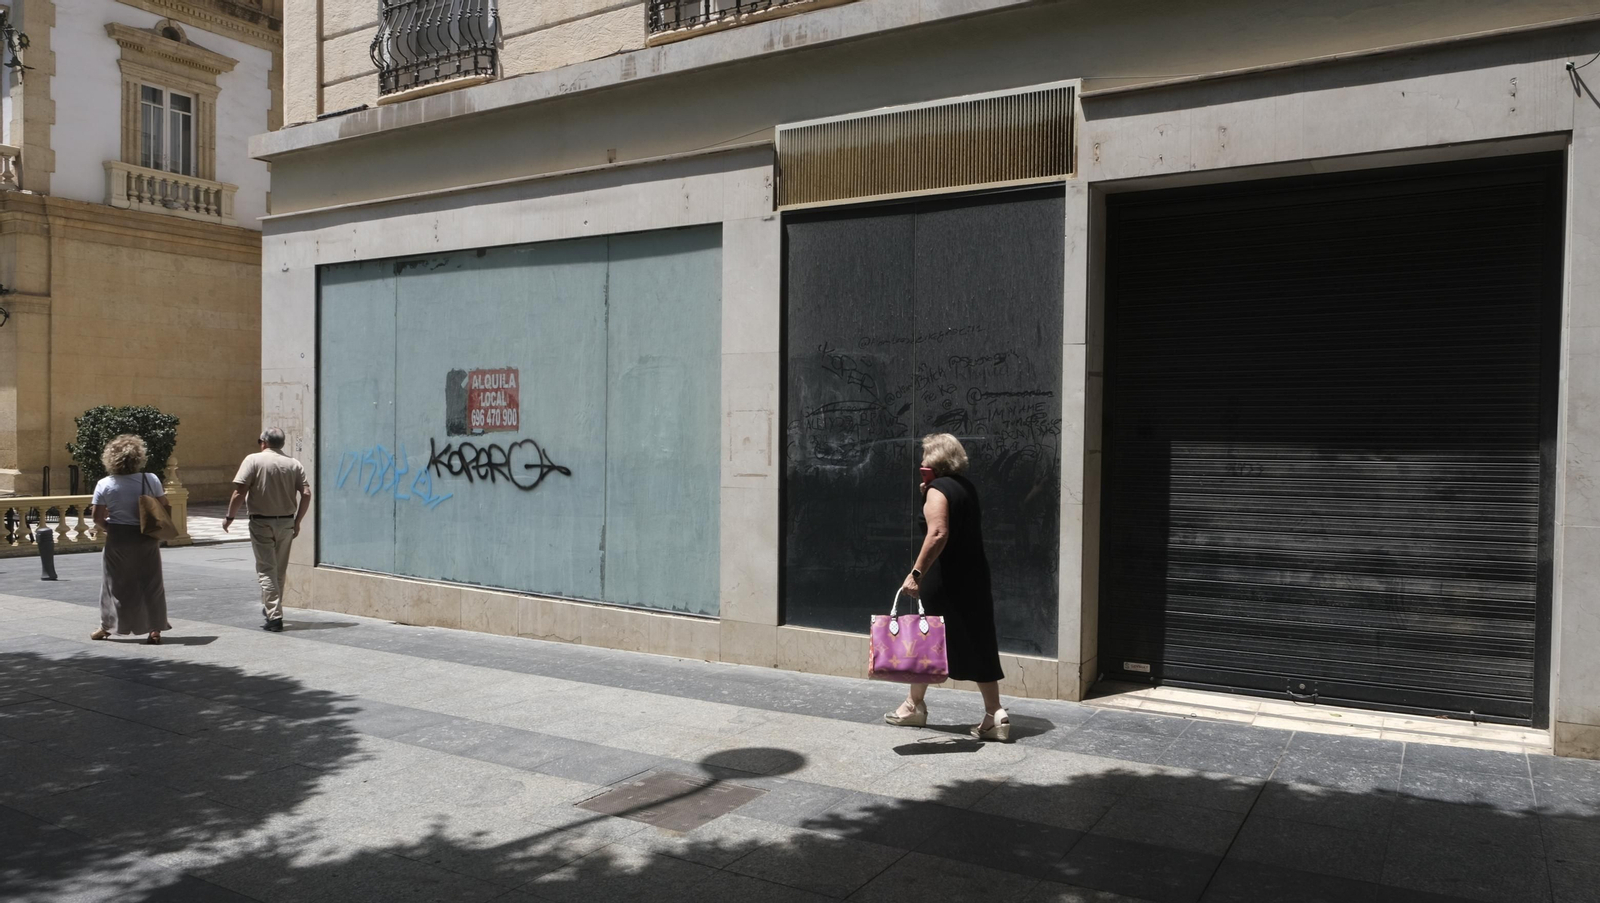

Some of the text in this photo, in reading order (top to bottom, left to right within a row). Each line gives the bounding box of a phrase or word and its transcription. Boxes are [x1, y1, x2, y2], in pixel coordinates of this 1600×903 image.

[471, 373, 516, 389] ALQUILA
[480, 391, 507, 406] LOCAL
[471, 408, 517, 426] 696 470 900
